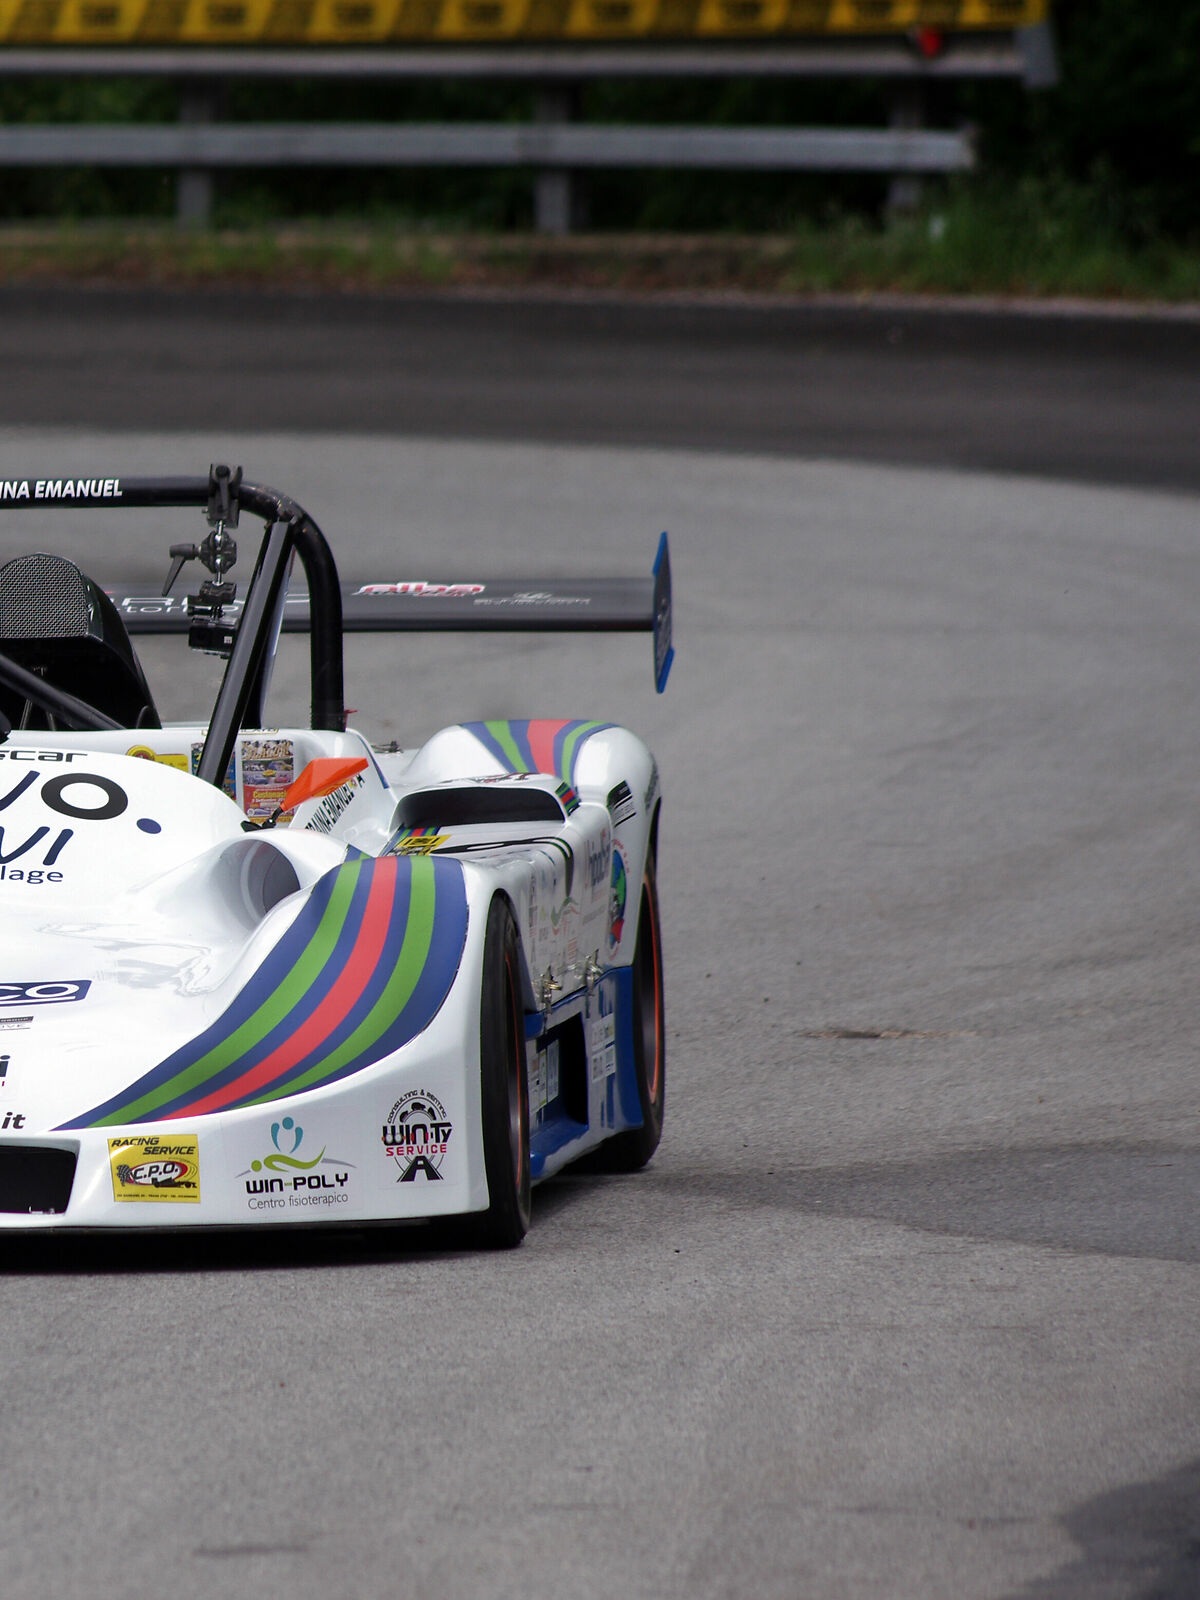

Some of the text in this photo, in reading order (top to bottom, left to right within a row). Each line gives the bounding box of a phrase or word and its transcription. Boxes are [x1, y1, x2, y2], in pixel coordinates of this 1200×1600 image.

[34, 479, 123, 498] EMANUEL
[111, 1137, 160, 1147] RACING
[143, 1146, 196, 1155] SERVICE
[386, 1144, 447, 1156] SERVICE
[246, 1172, 349, 1194] WIN-POLY
[248, 1192, 349, 1210] Centro fisioterapico
